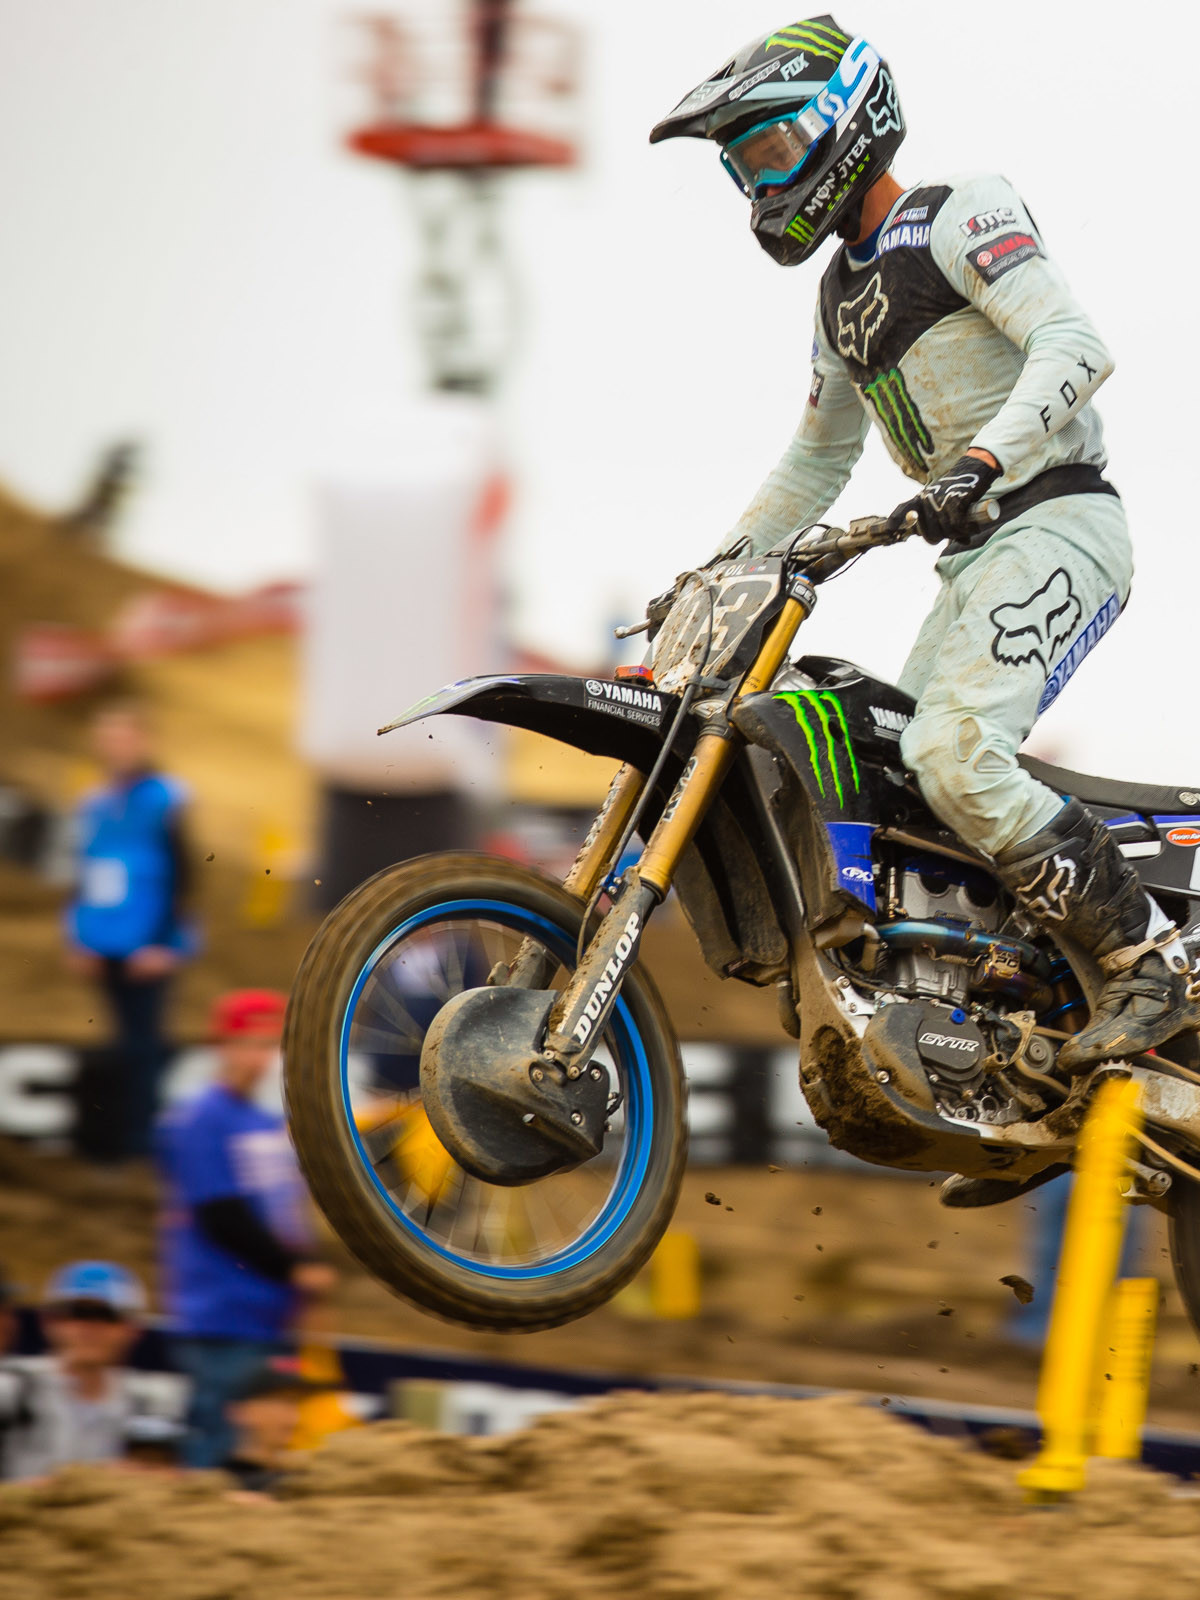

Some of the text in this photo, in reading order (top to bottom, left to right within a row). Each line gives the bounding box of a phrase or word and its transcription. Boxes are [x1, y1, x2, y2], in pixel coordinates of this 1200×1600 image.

[780, 52, 810, 81] FOX
[804, 134, 872, 216] MONSTER
[827, 153, 870, 211] ENERGY
[1054, 591, 1120, 691] YAMAHA
[587, 700, 661, 727] FINANCIAL SERVICES
[603, 683, 662, 712] YAMAHA
[572, 911, 640, 1045] DUNLOP
[918, 1032, 980, 1052] GYTR
